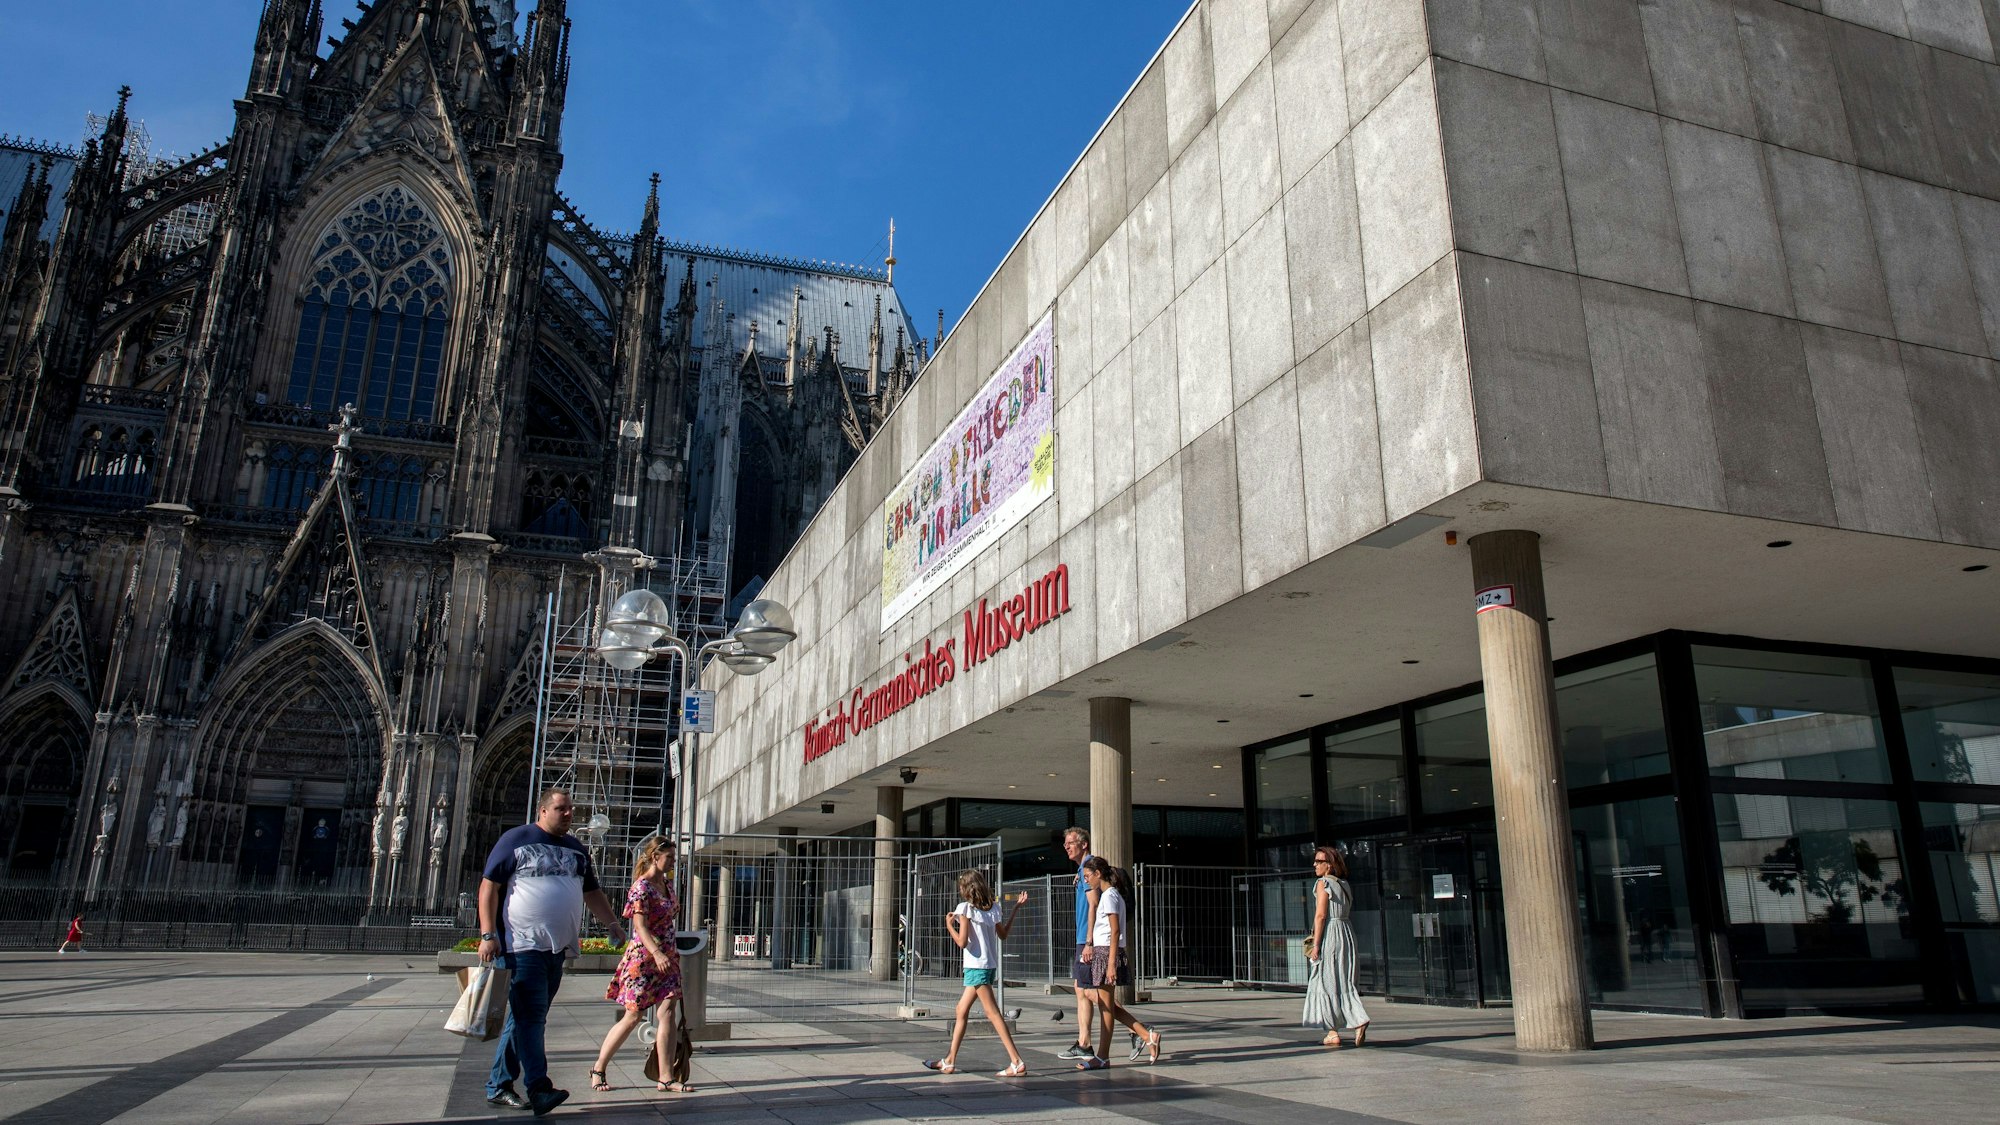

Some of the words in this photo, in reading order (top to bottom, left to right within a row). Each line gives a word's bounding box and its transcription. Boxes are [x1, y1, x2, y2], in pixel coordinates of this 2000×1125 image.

[922, 569, 931, 584] WIR
[931, 557, 947, 577] ZEIGEN
[947, 520, 990, 563] ZUSAMMENHALT!
[804, 638, 956, 765] Römisch-Germanisches
[963, 563, 1072, 672] Museum
